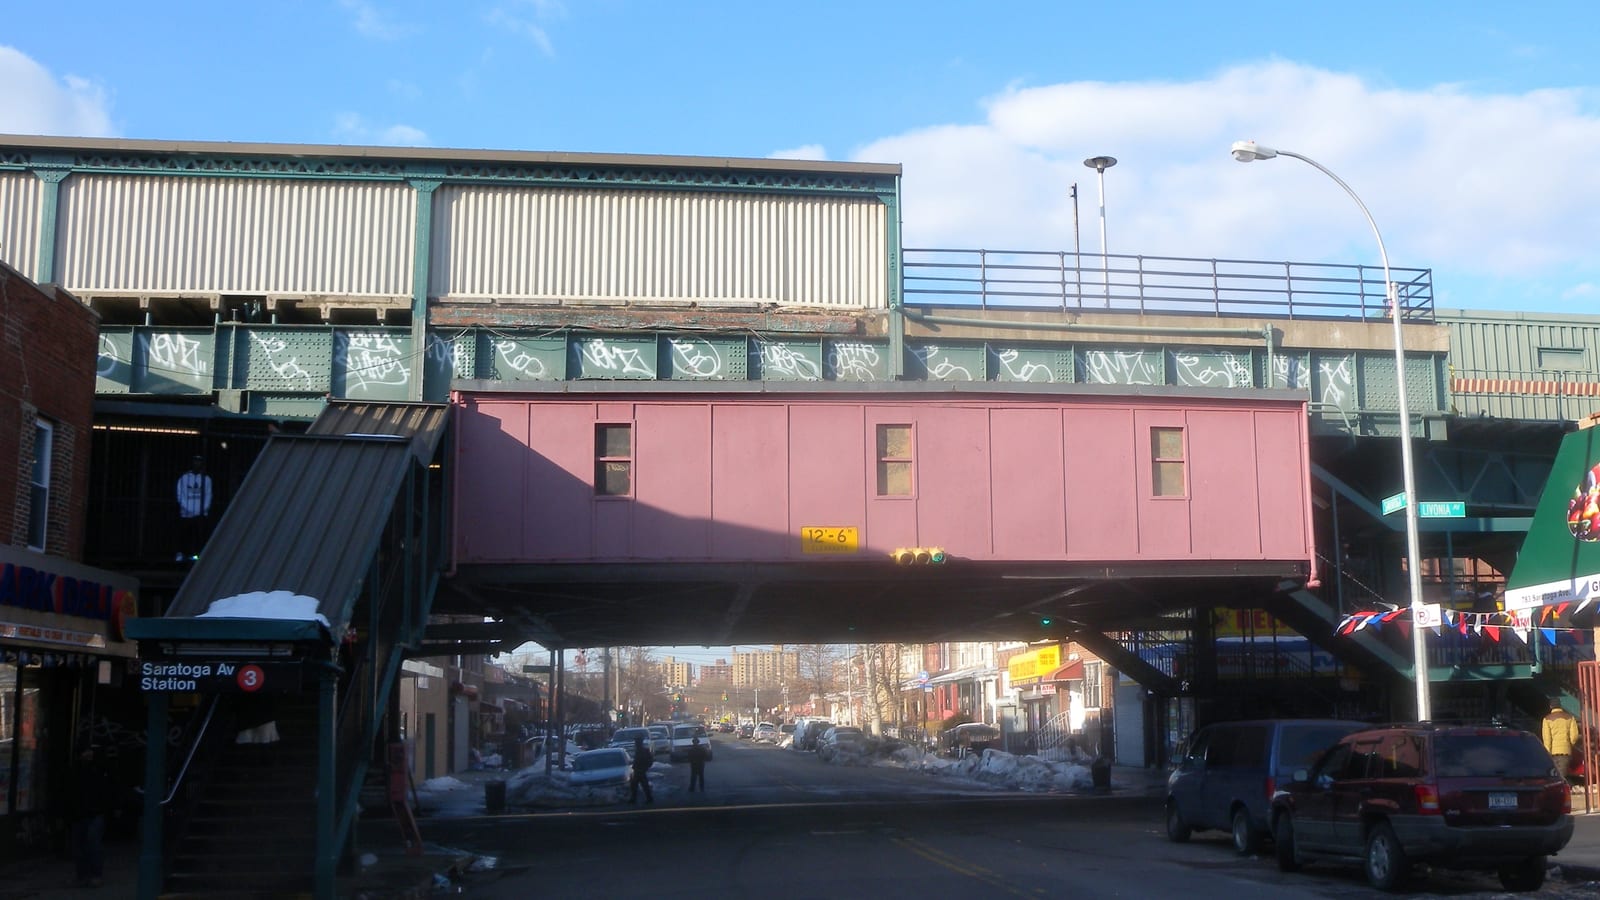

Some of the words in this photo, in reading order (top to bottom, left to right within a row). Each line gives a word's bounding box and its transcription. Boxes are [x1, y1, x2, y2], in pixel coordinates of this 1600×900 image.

[1422, 503, 1451, 516] LIVONIA
[58, 576, 112, 620] DELI
[1532, 592, 1557, 602] Saratoga
[142, 663, 211, 678] Saratoga
[217, 663, 235, 675] Av
[142, 678, 196, 690] Station
[244, 670, 257, 686] 3
